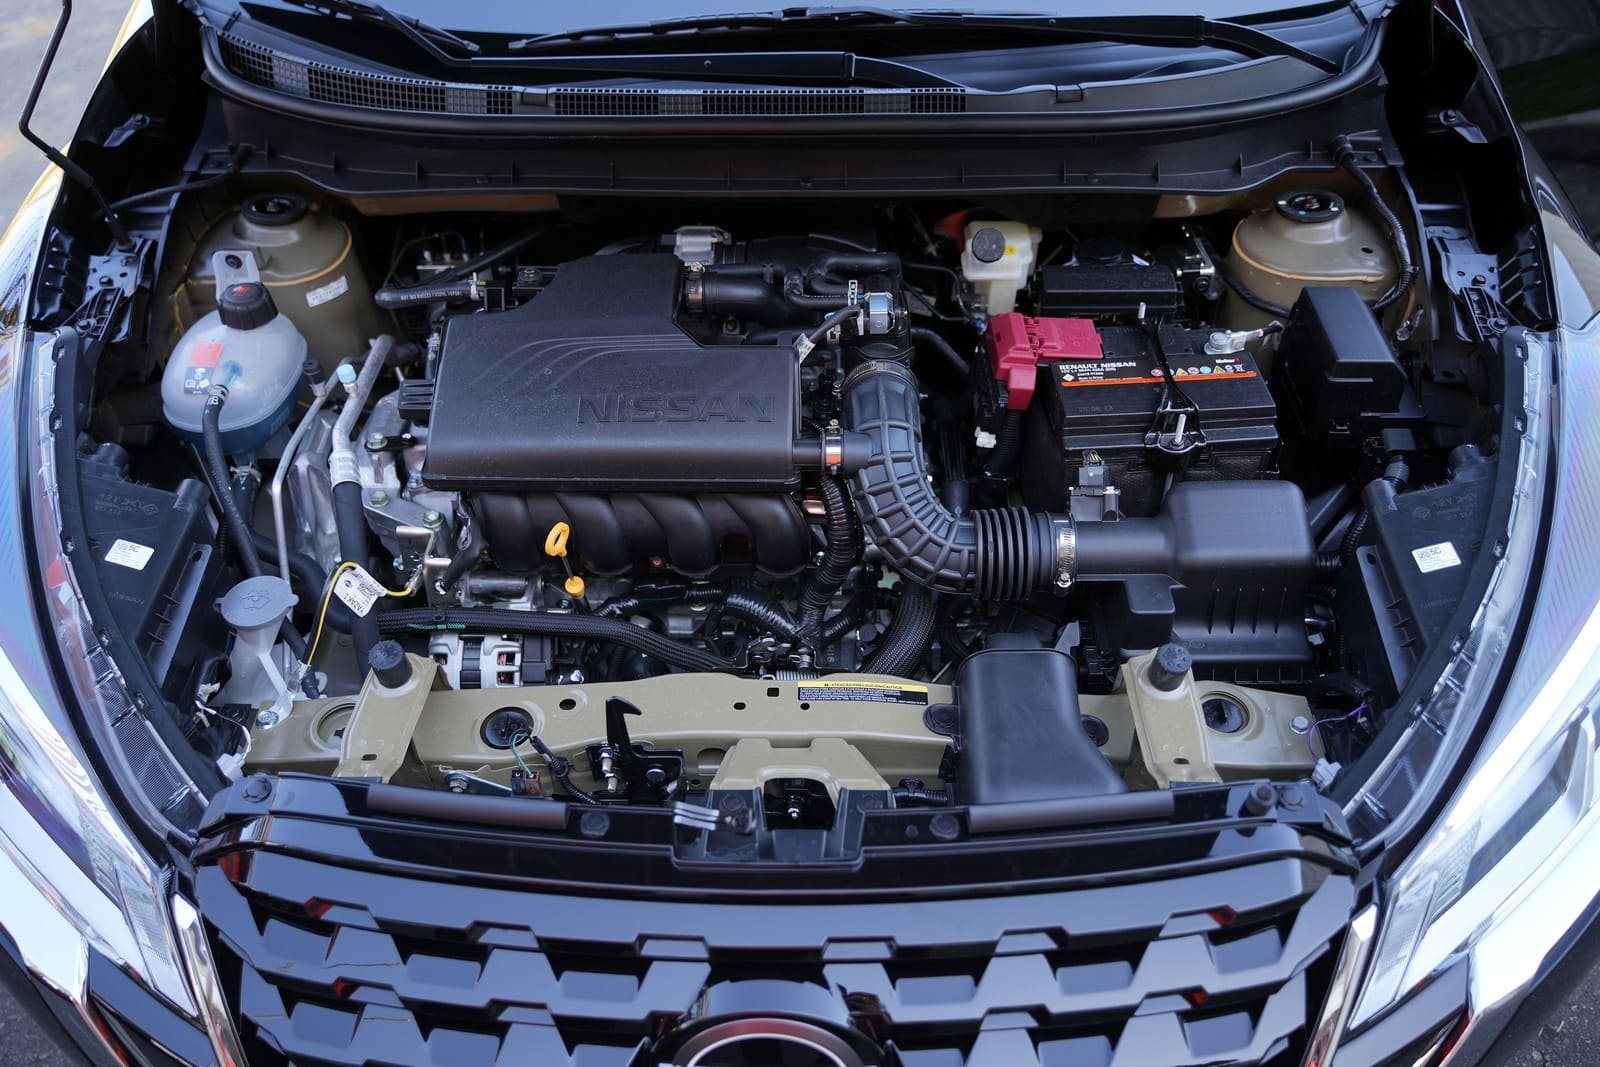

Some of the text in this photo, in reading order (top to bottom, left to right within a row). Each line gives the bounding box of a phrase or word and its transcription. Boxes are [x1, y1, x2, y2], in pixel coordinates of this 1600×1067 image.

[1059, 361, 1137, 371] RENAULT NISSAN
[577, 393, 774, 424] NISSAN
